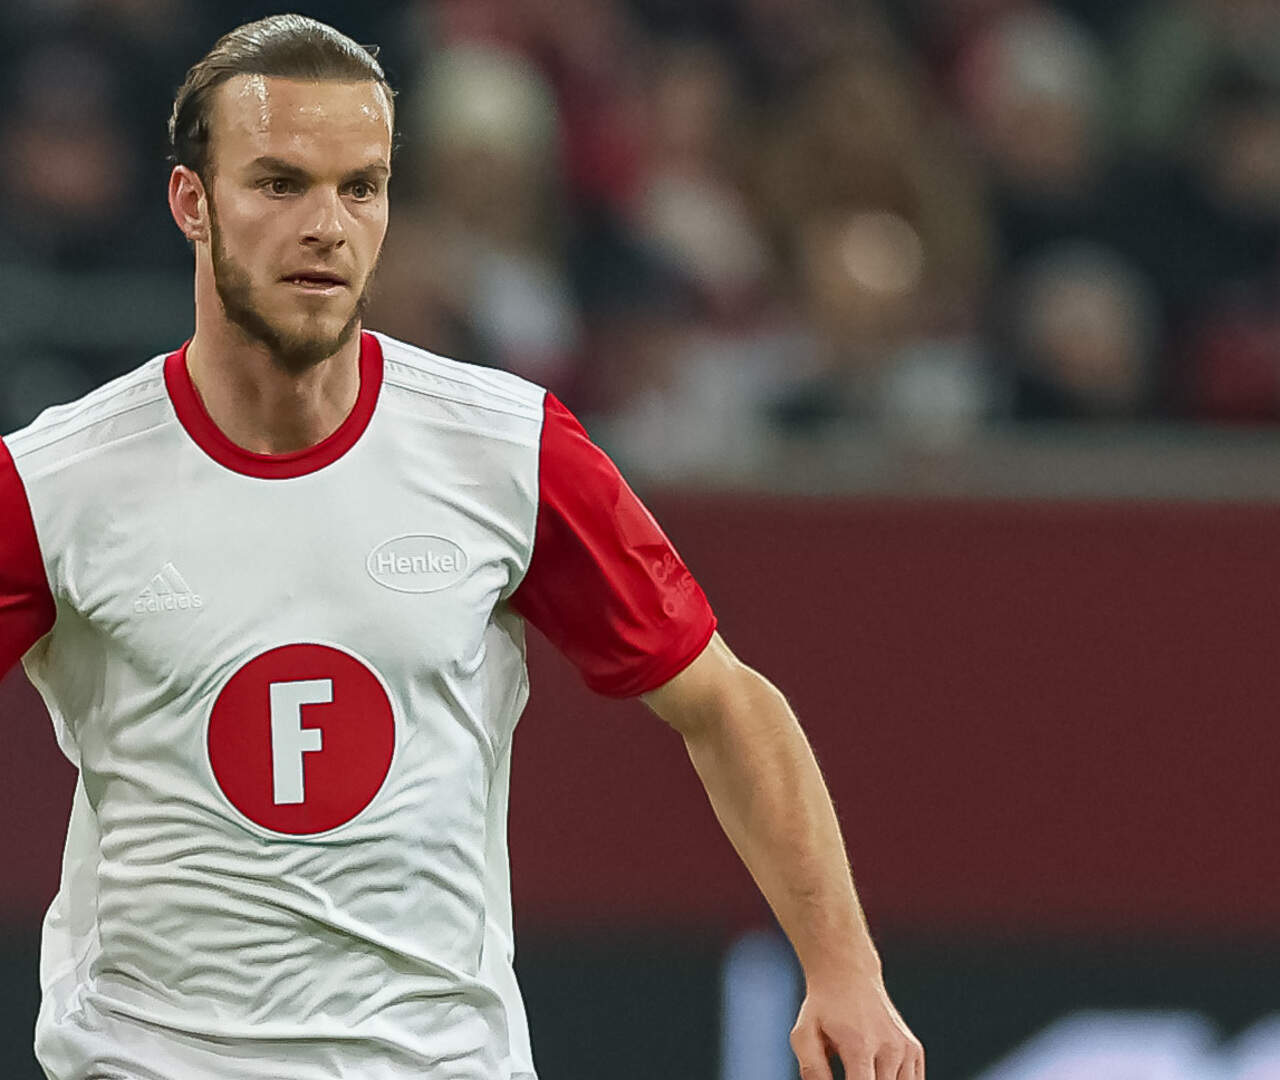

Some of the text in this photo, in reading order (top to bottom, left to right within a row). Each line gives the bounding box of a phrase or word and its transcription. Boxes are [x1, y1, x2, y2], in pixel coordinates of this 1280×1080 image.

[376, 550, 461, 574] Henkel
[134, 593, 202, 614] adidas
[269, 678, 333, 805] F
